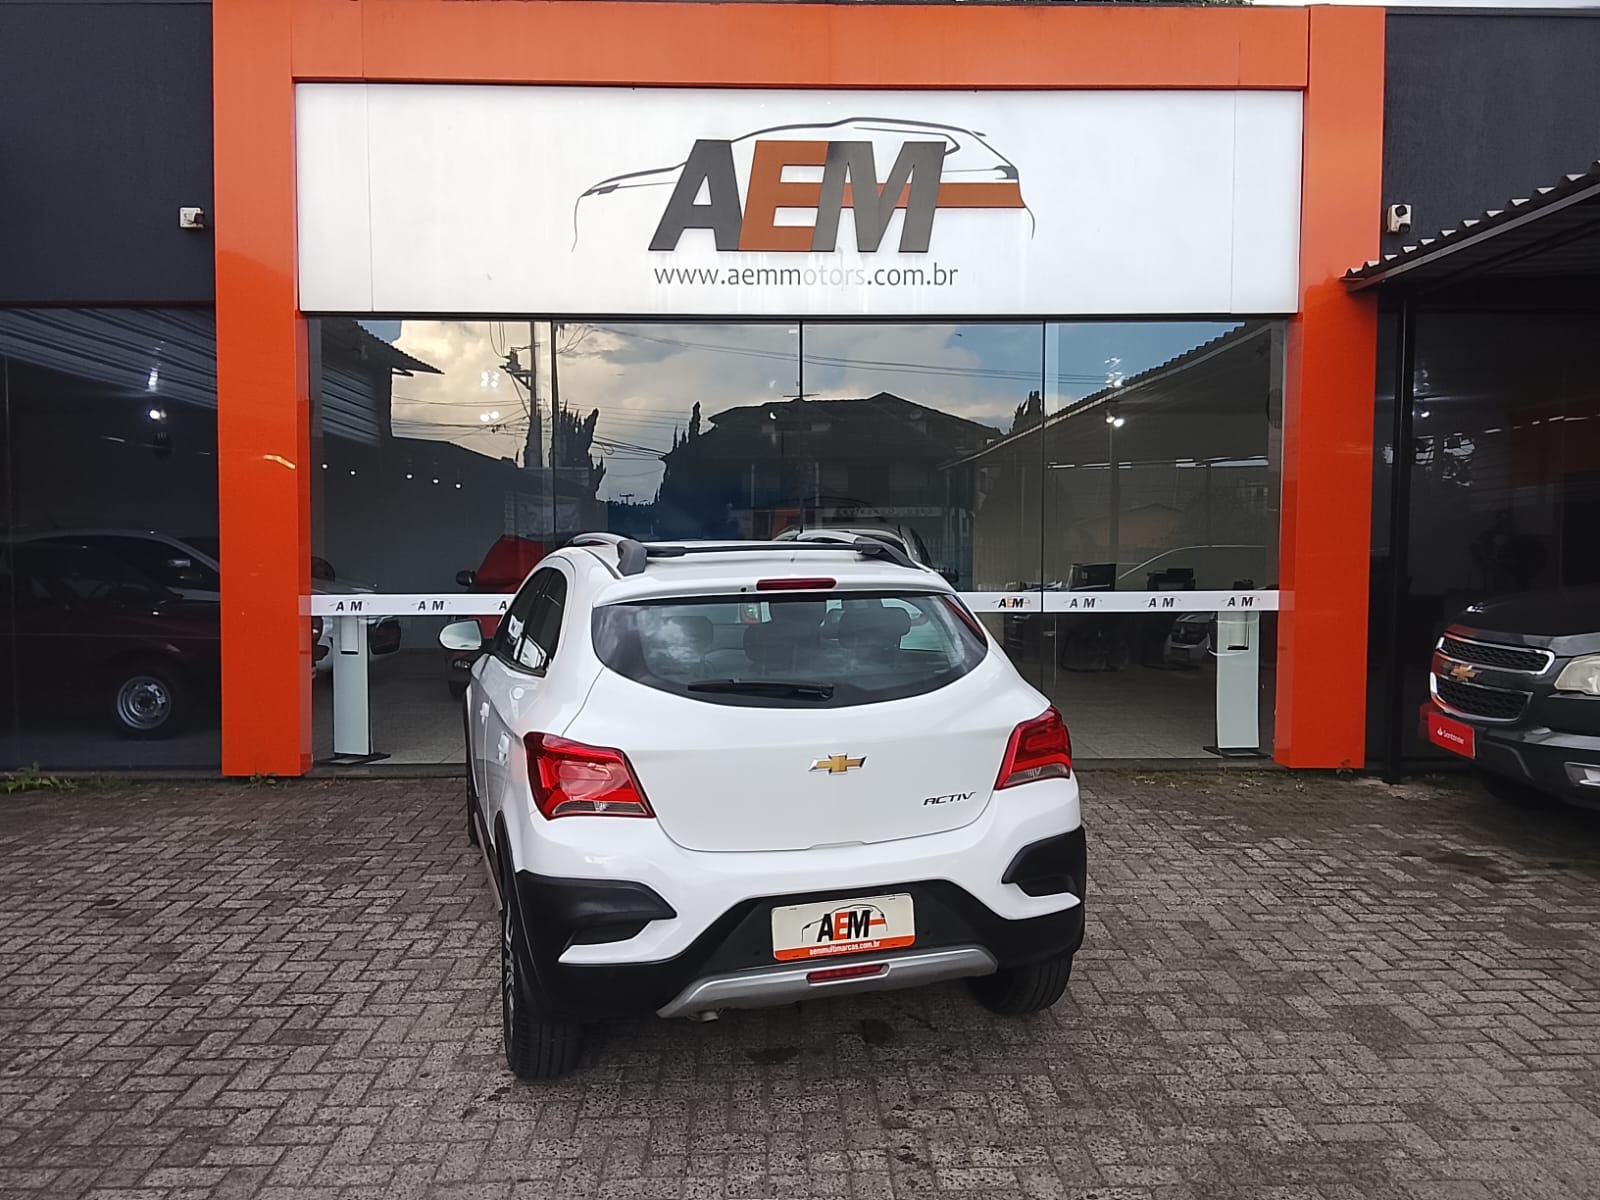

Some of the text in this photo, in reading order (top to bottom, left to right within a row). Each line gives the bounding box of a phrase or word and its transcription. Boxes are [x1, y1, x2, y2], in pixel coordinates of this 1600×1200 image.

[648, 139, 947, 252] AEM
[655, 262, 958, 287] www.aemmotors.com.br
[998, 598, 1024, 609] AEM
[923, 791, 977, 806] ACTIV
[816, 909, 872, 943] AEM
